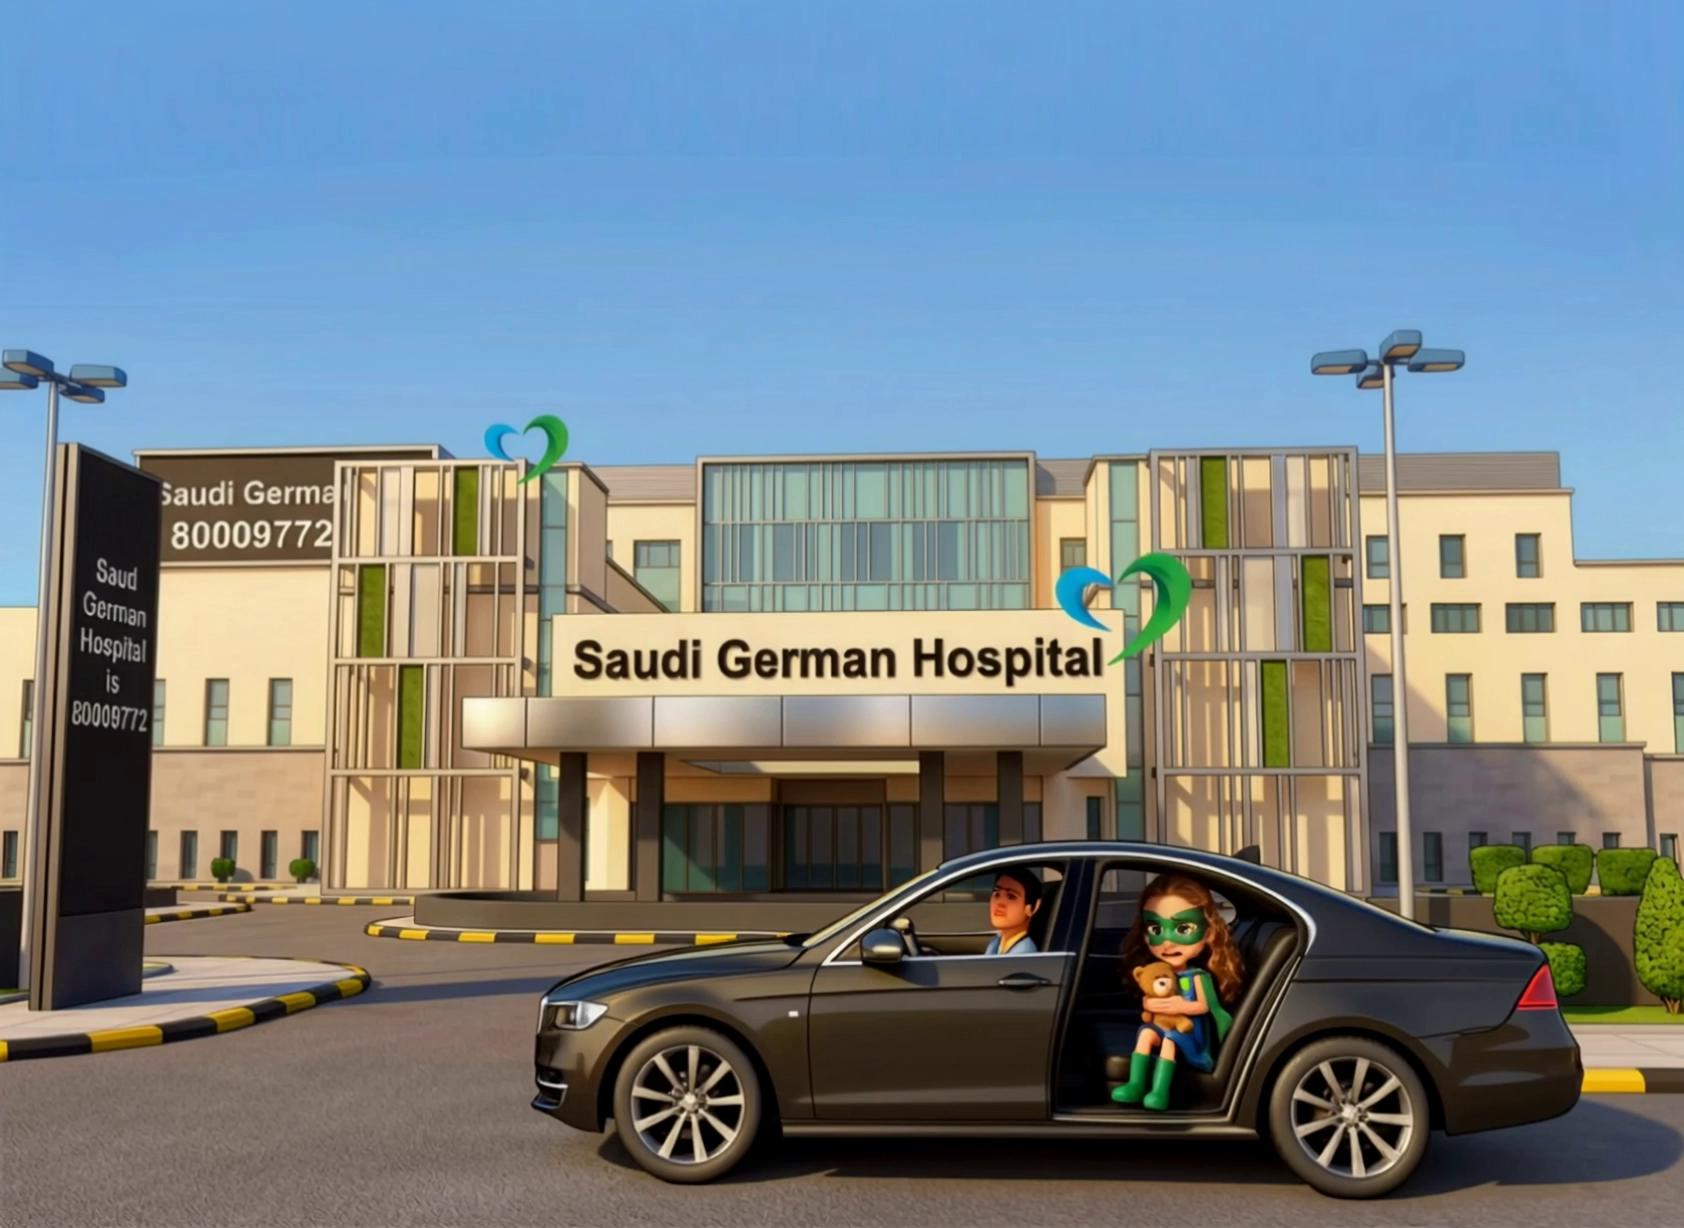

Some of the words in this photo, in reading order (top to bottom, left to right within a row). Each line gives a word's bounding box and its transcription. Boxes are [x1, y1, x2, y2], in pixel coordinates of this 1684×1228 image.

[244, 480, 348, 505] Germa
[171, 520, 333, 549] 80009772
[96, 557, 138, 591] Saud
[83, 590, 146, 628] German
[80, 626, 147, 664] Hospital
[573, 639, 702, 680] Saudi
[717, 638, 897, 679] German
[912, 637, 1103, 687] Hospital
[106, 668, 120, 694] is
[72, 700, 148, 732] 80009772
